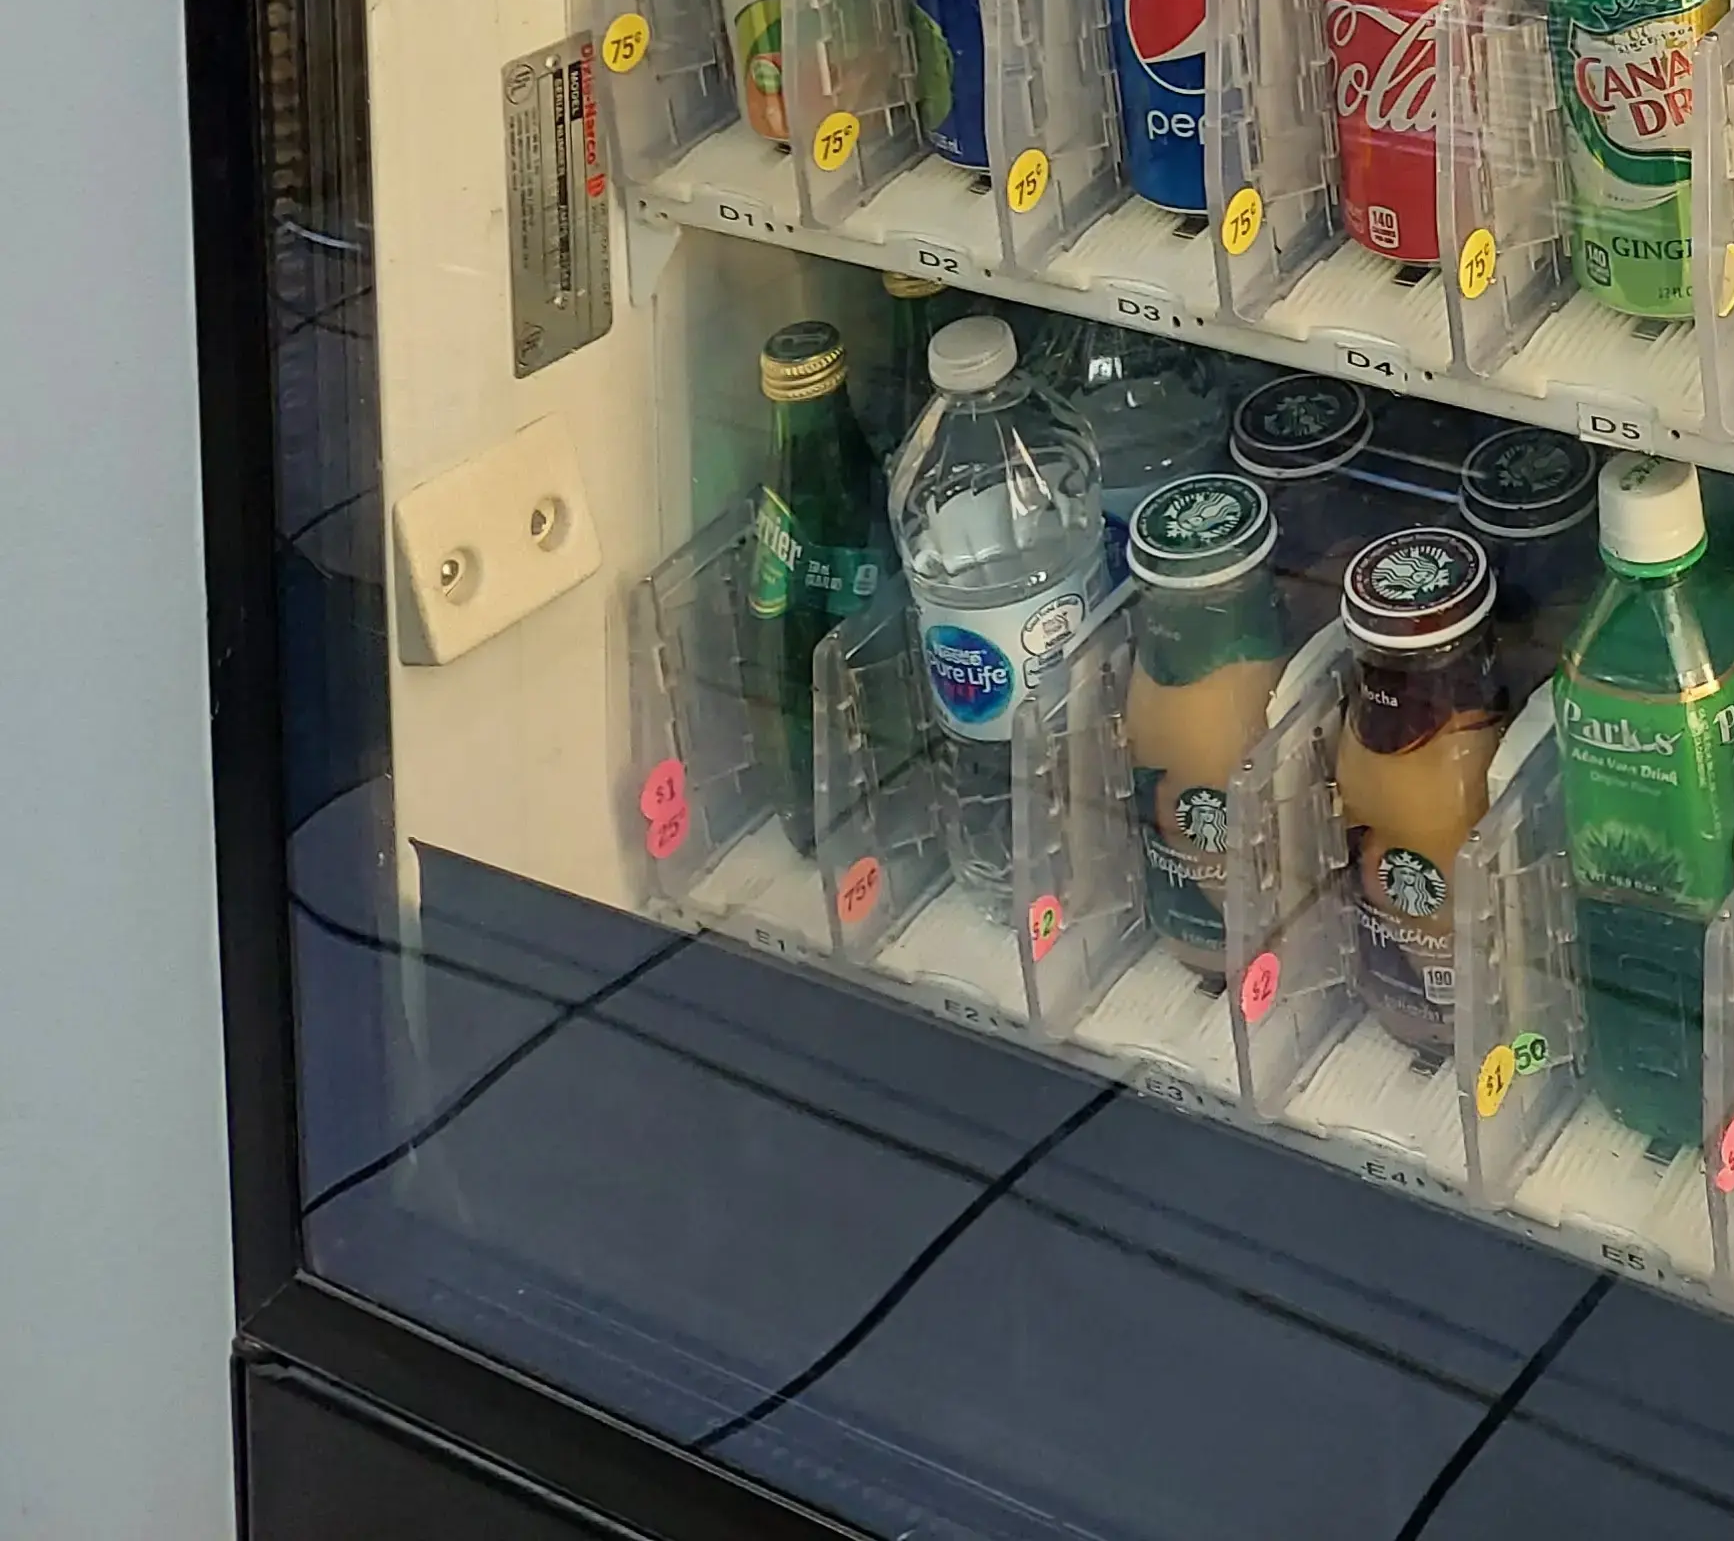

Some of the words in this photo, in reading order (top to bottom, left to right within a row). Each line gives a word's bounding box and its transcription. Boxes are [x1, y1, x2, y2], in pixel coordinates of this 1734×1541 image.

[610, 30, 642, 63] 75¢
[721, 204, 753, 224] D1
[920, 250, 960, 273] D2
[1117, 297, 1161, 321] D3
[1346, 350, 1394, 376] D4
[1590, 415, 1640, 439] D5
[967, 667, 1008, 693] Life
[756, 928, 786, 952] E1
[944, 998, 980, 1021] E2
[1145, 1077, 1184, 1102] E3
[1366, 1160, 1408, 1186] E4
[1602, 1243, 1646, 1270] E5
